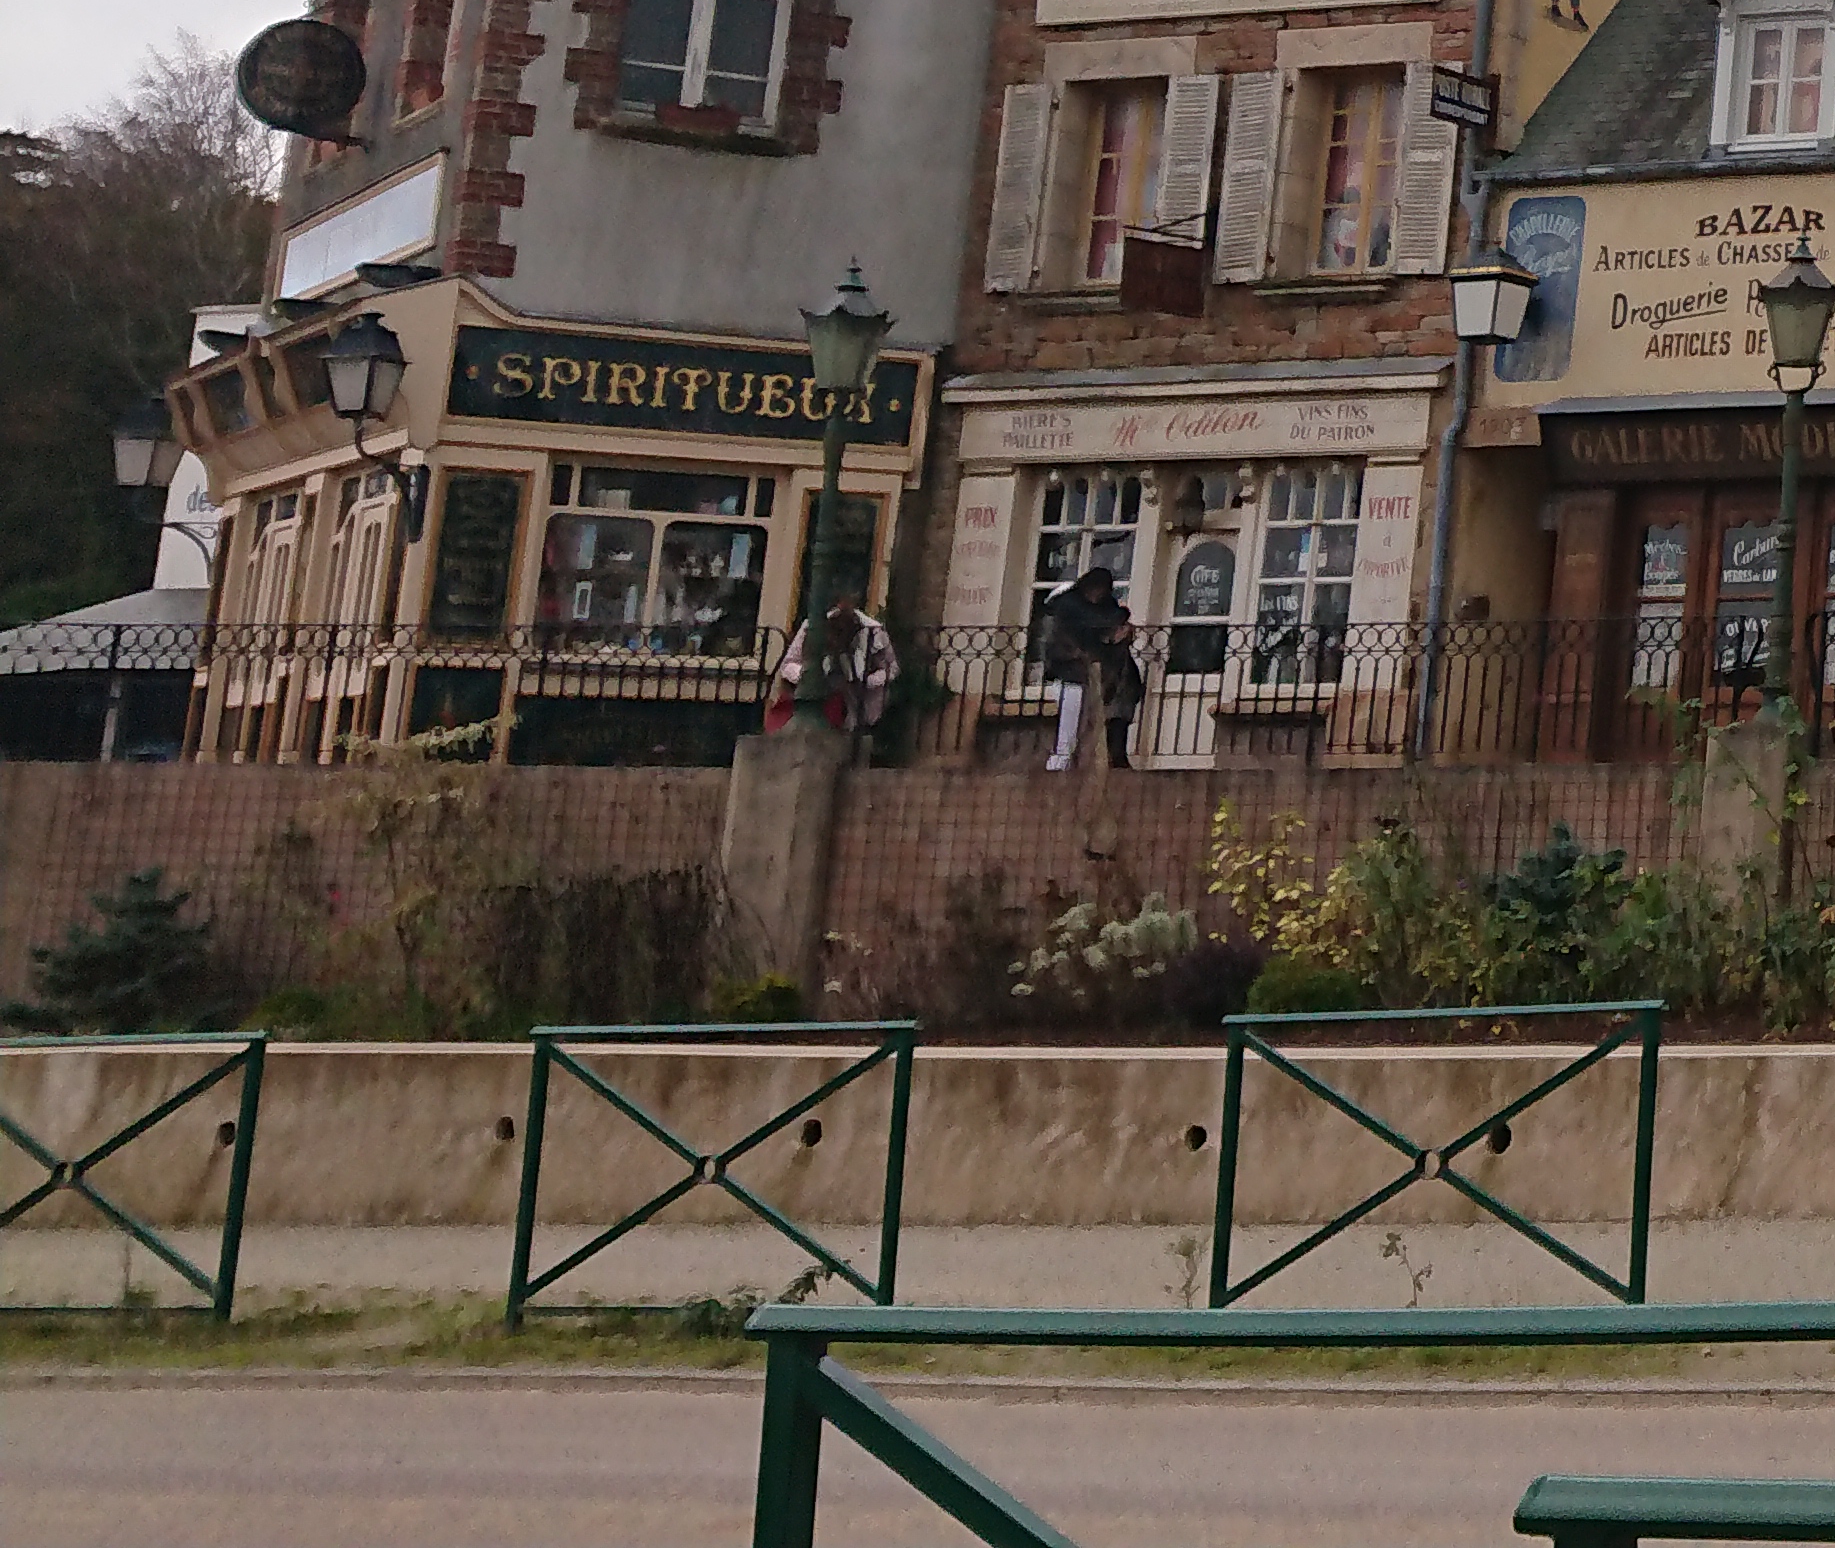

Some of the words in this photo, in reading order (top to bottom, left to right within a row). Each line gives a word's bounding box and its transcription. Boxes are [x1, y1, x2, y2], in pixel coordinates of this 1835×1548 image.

[1694, 204, 1826, 239] BAZAR
[1593, 244, 1691, 273] ARTICLES
[1611, 282, 1728, 330] Droguerie
[1645, 329, 1732, 359] ARTICLES
[1744, 329, 1769, 355] DE
[1289, 426, 1311, 441] DU
[1317, 425, 1375, 442] PATRON
[1571, 424, 1724, 466] GALERIE
[1368, 495, 1415, 520] VENTE
